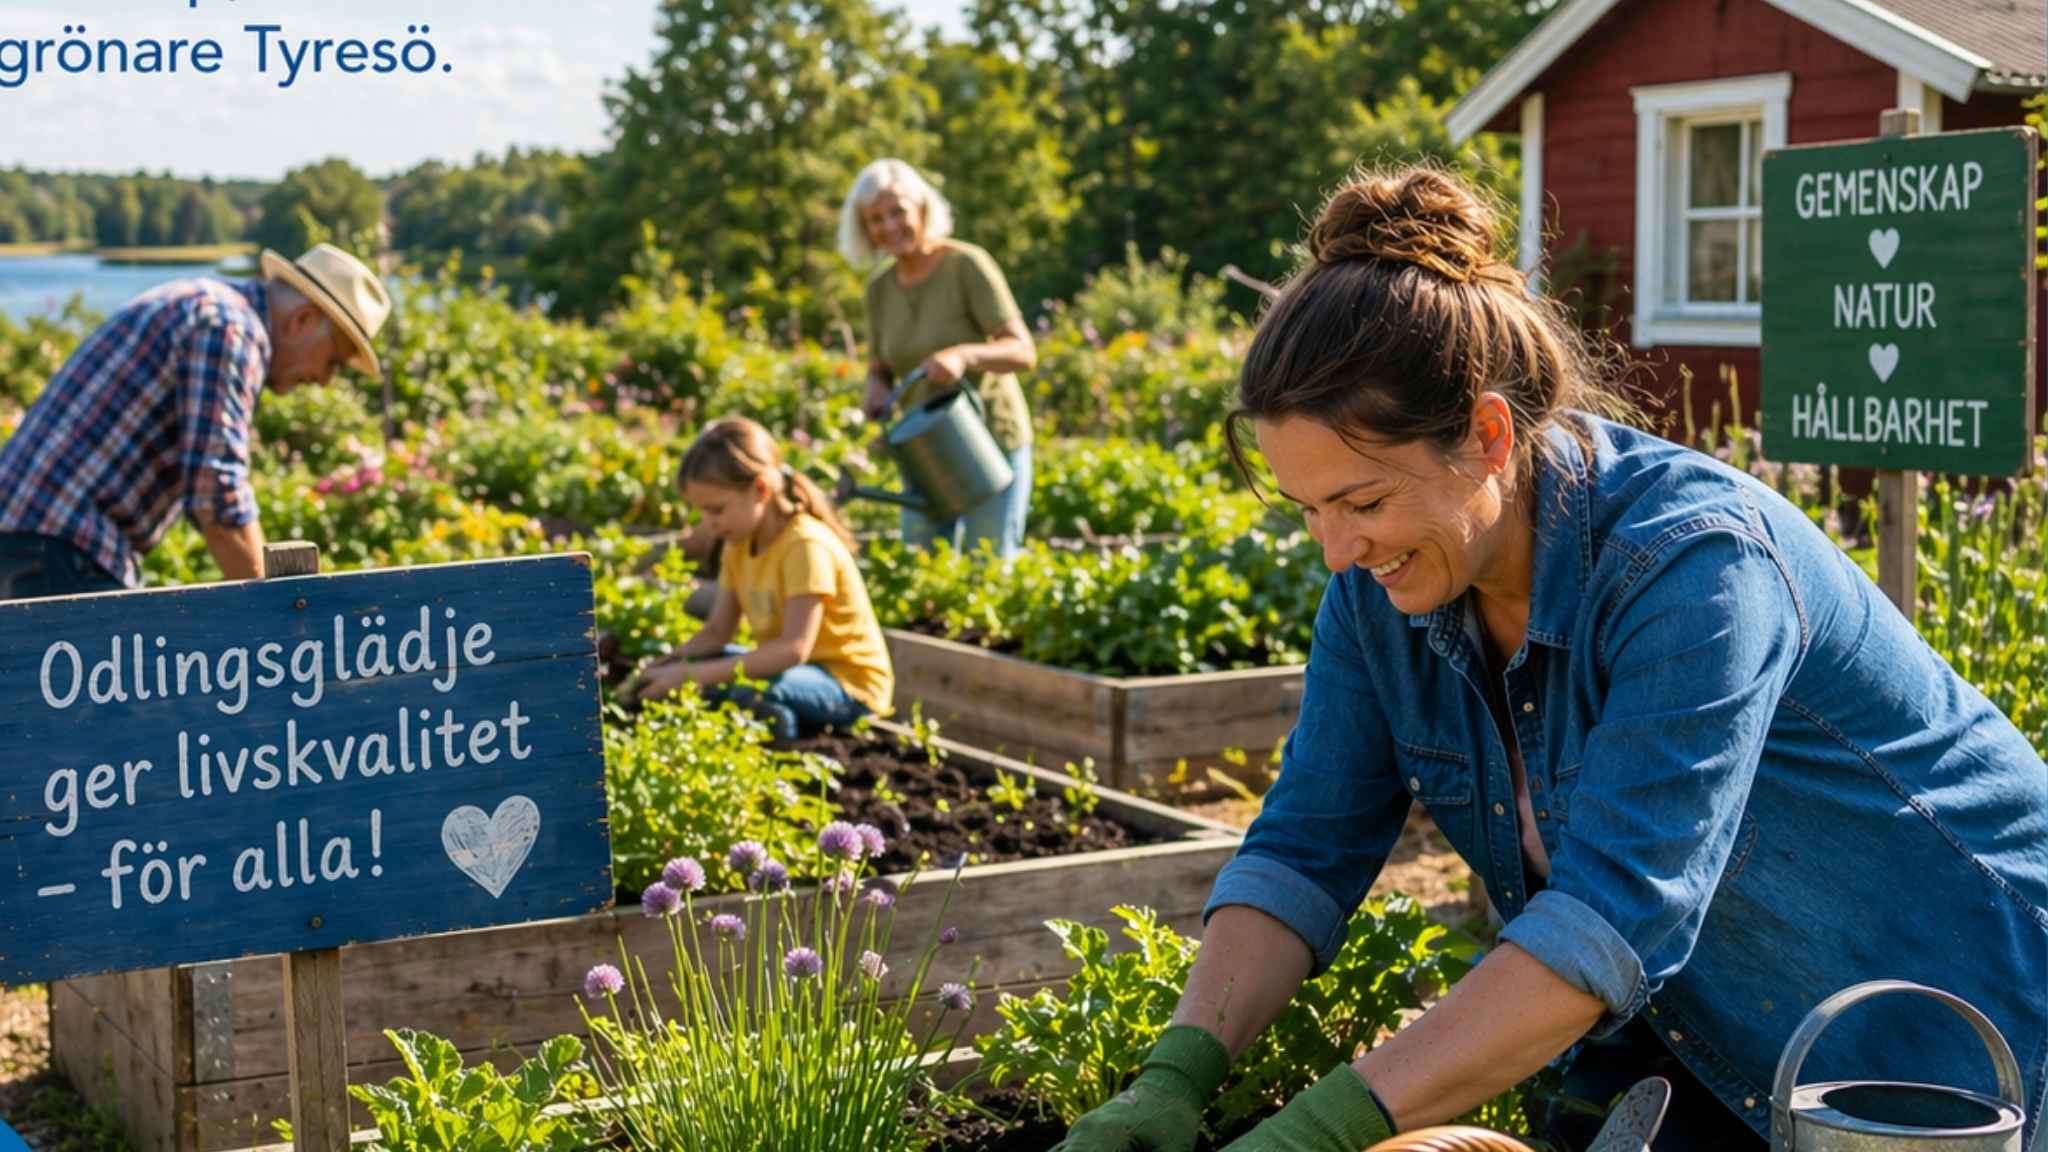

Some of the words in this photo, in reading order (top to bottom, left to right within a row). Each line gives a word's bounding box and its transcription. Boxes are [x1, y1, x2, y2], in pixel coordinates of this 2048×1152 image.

[1795, 161, 1984, 220] GEMENSKAP
[1834, 282, 1937, 330] NATUR
[1791, 381, 1989, 449] HÅLLBARHET
[39, 605, 496, 715] Odlingsglädje
[43, 762, 153, 837] ger
[178, 700, 533, 799] livskvalitet
[101, 839, 207, 910] för
[232, 808, 383, 893] alla!
